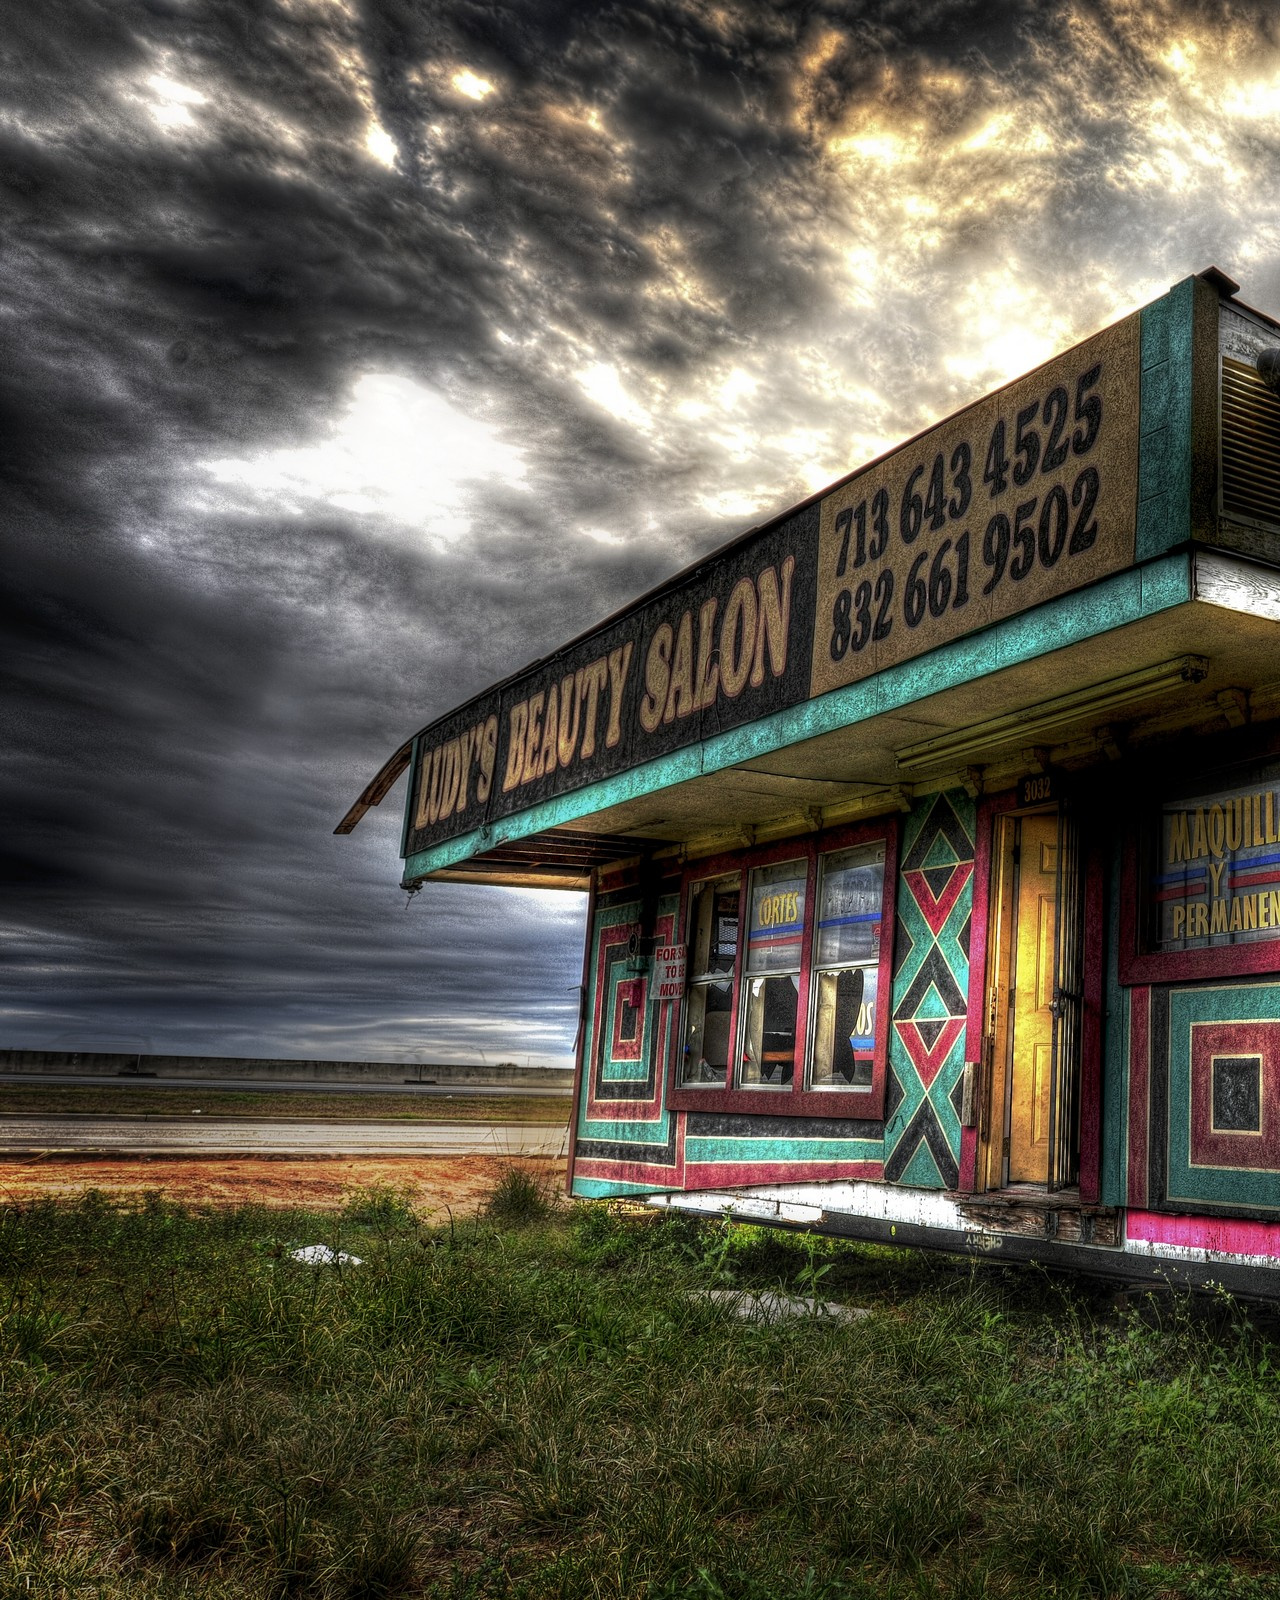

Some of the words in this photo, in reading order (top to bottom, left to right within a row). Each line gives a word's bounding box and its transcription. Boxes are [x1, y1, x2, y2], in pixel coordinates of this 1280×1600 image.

[834, 488, 889, 577] 713
[900, 441, 972, 544] 643
[983, 363, 1102, 498] 4525
[830, 568, 894, 661] 832
[903, 531, 970, 628] 661
[982, 466, 1100, 596] 9502
[414, 713, 498, 831] LUDY'S
[502, 640, 634, 793] BEAUTY
[640, 554, 795, 733] SALON
[1024, 776, 1051, 802] 3032
[1209, 862, 1225, 897] Y
[758, 891, 799, 926] CORTES
[656, 947, 676, 961] FOR
[659, 982, 685, 996] MOVE
[665, 965, 677, 979] TO
